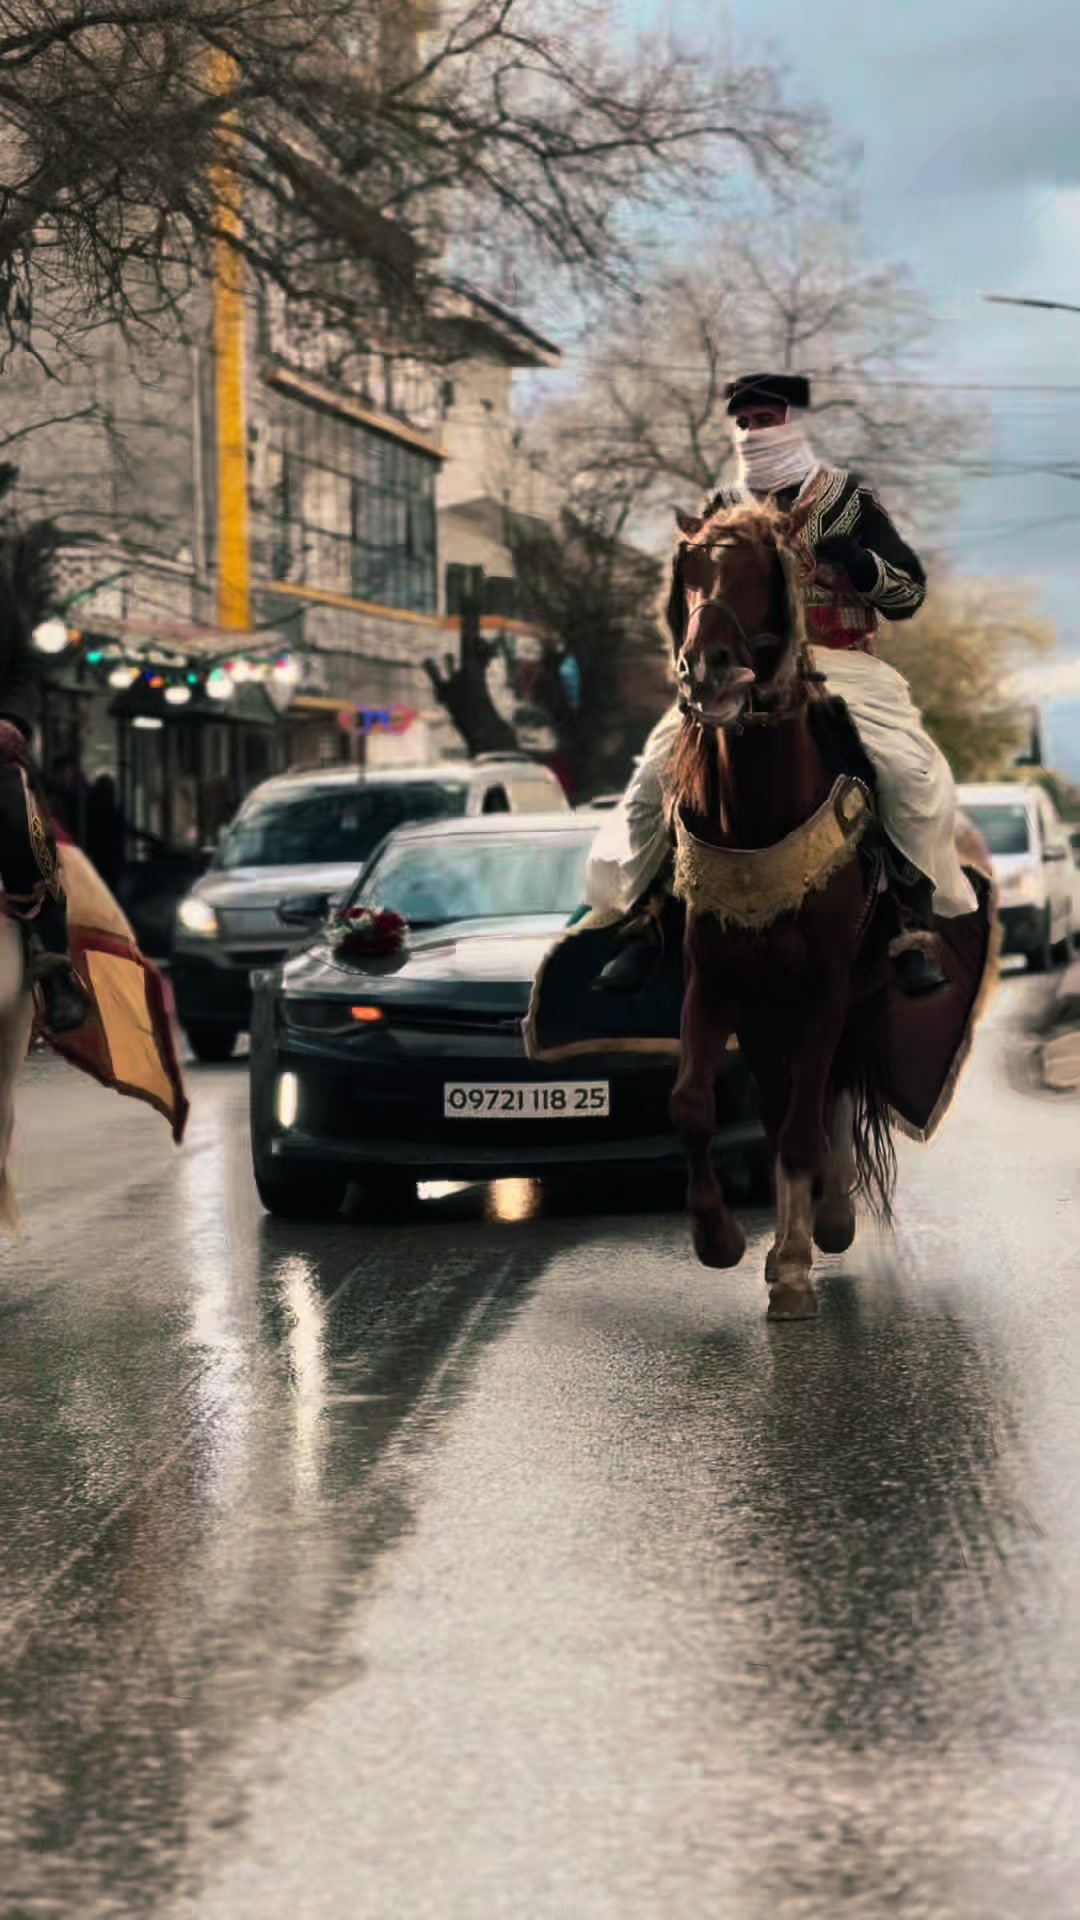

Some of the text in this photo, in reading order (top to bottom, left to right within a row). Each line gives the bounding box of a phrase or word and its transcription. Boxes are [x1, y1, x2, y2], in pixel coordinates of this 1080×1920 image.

[448, 1087, 605, 1111] 09721 118 25
